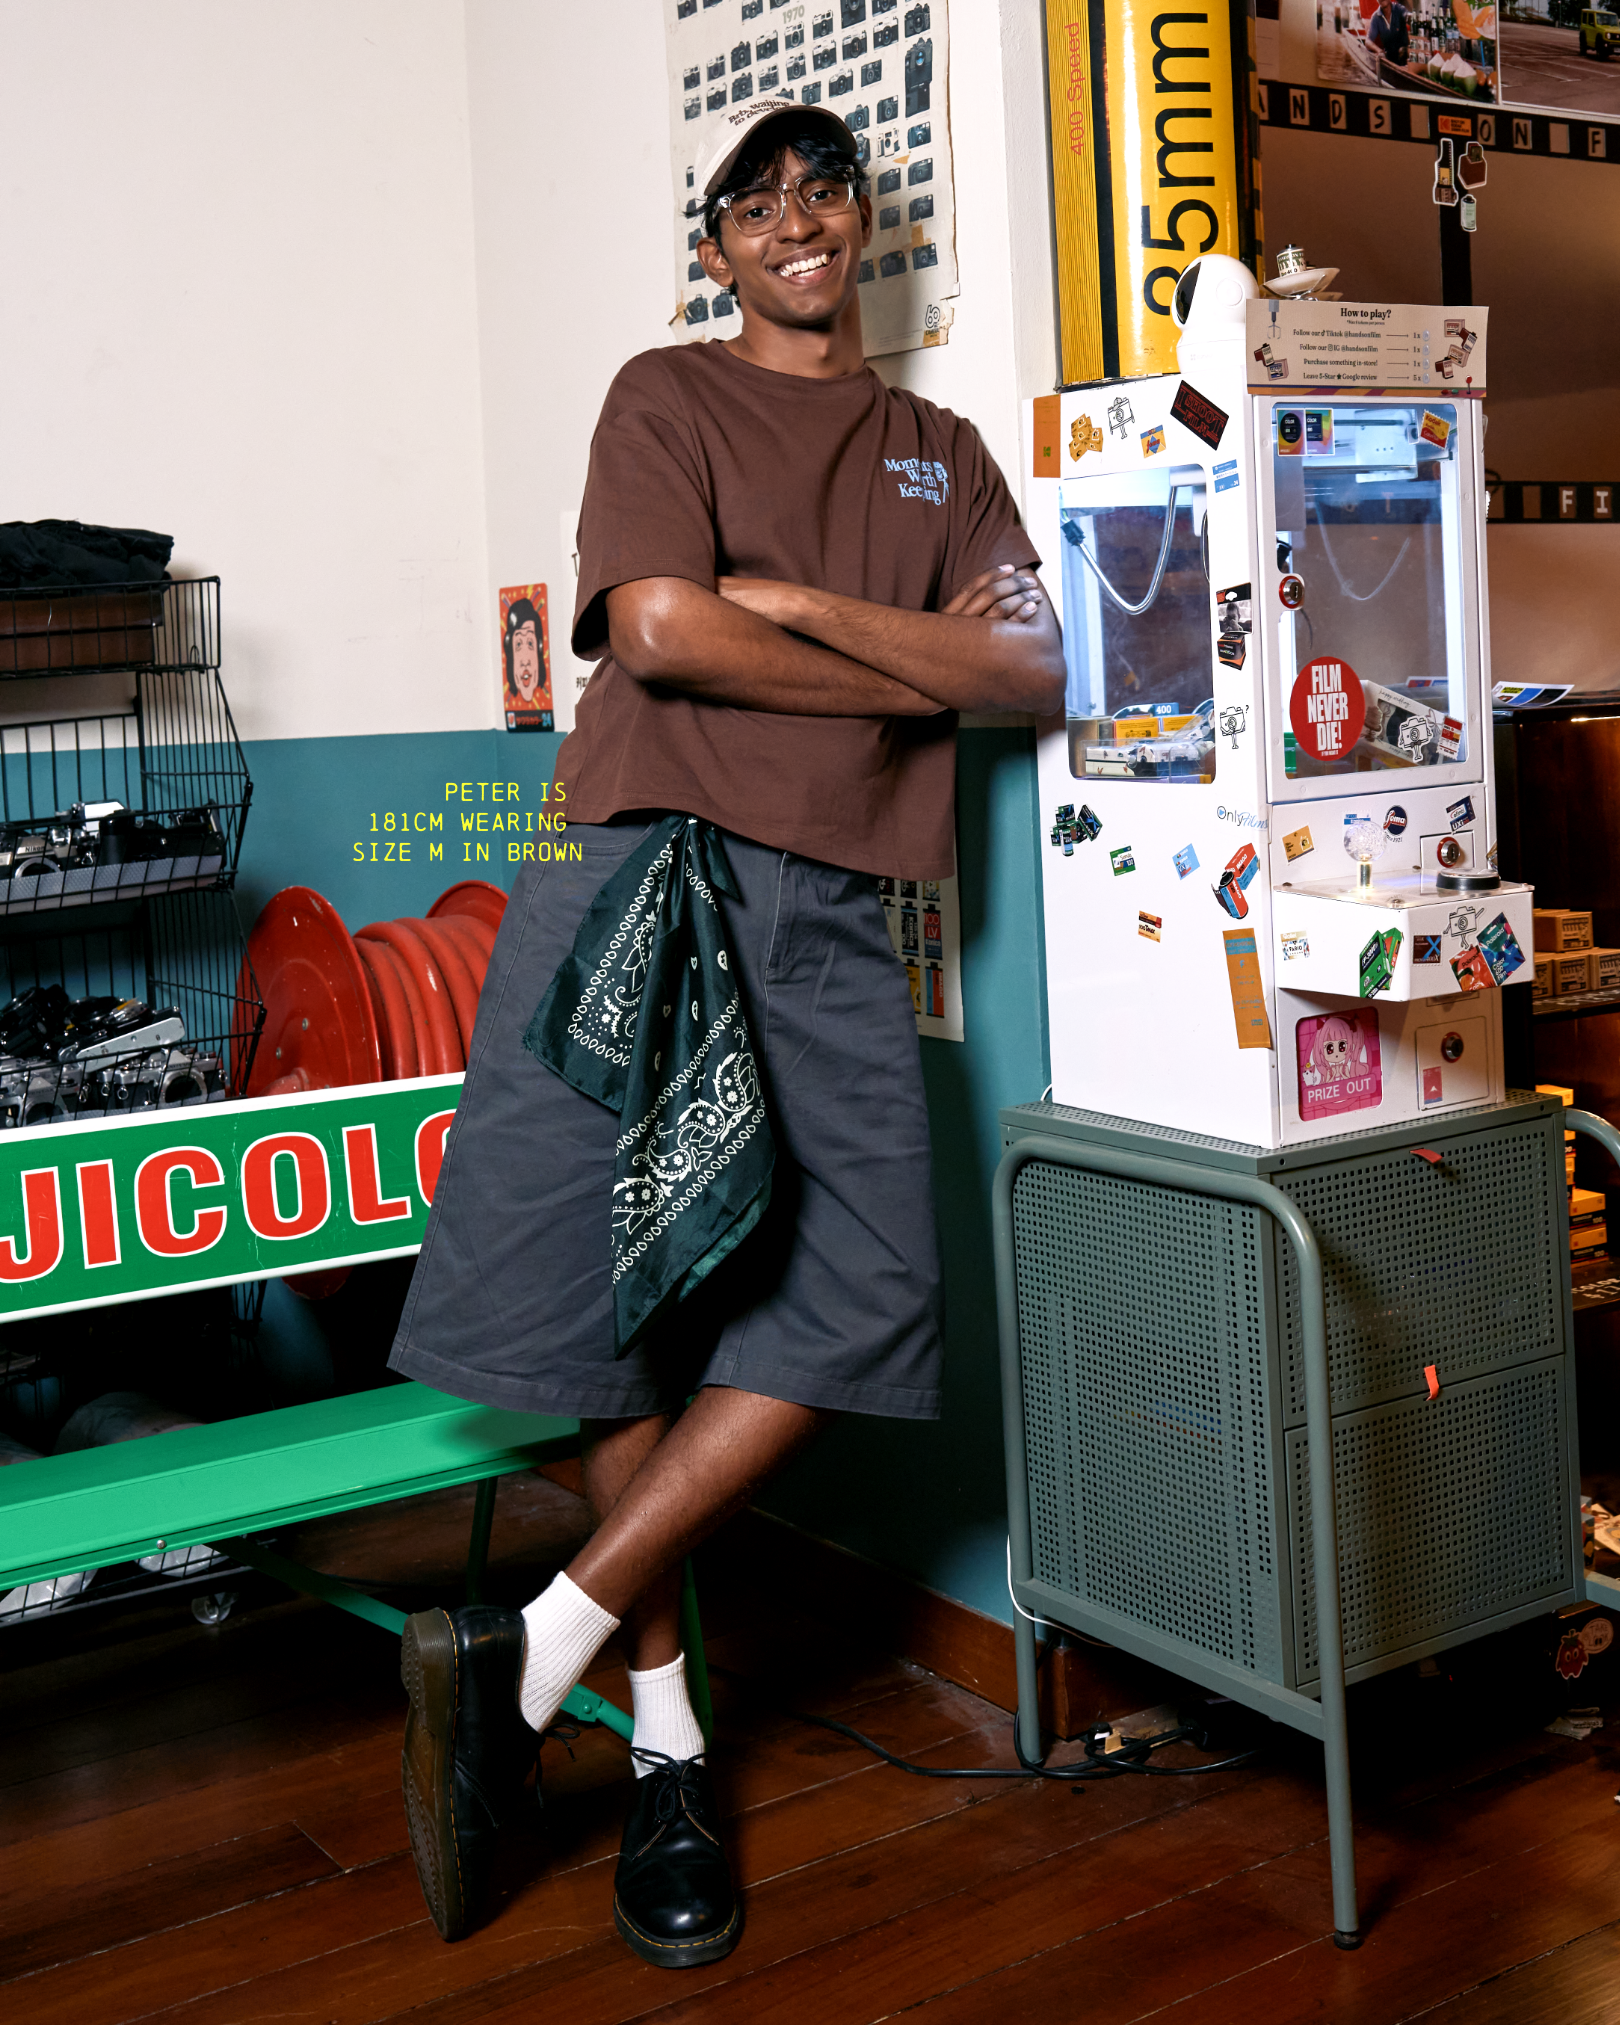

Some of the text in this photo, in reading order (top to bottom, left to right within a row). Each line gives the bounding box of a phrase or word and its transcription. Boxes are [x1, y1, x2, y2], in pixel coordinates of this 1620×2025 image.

[782, 5, 805, 24] 1970
[1064, 22, 1086, 156] 400 Speed
[1340, 308, 1392, 320] How to play?
[1184, 394, 1226, 436] SHOOT
[1426, 414, 1441, 427] Kodak
[904, 468, 937, 488] Wrth
[1312, 664, 1342, 694] FILM
[1156, 705, 1172, 714] 400
[1307, 692, 1349, 723] NEVER
[1316, 721, 1342, 751] DIE!
[925, 913, 940, 924] 100
[928, 926, 937, 938] LV
[1486, 927, 1505, 946] Polaroid
[1462, 952, 1479, 968] Polaroid
[1308, 1078, 1371, 1103] PRIZE OUT
